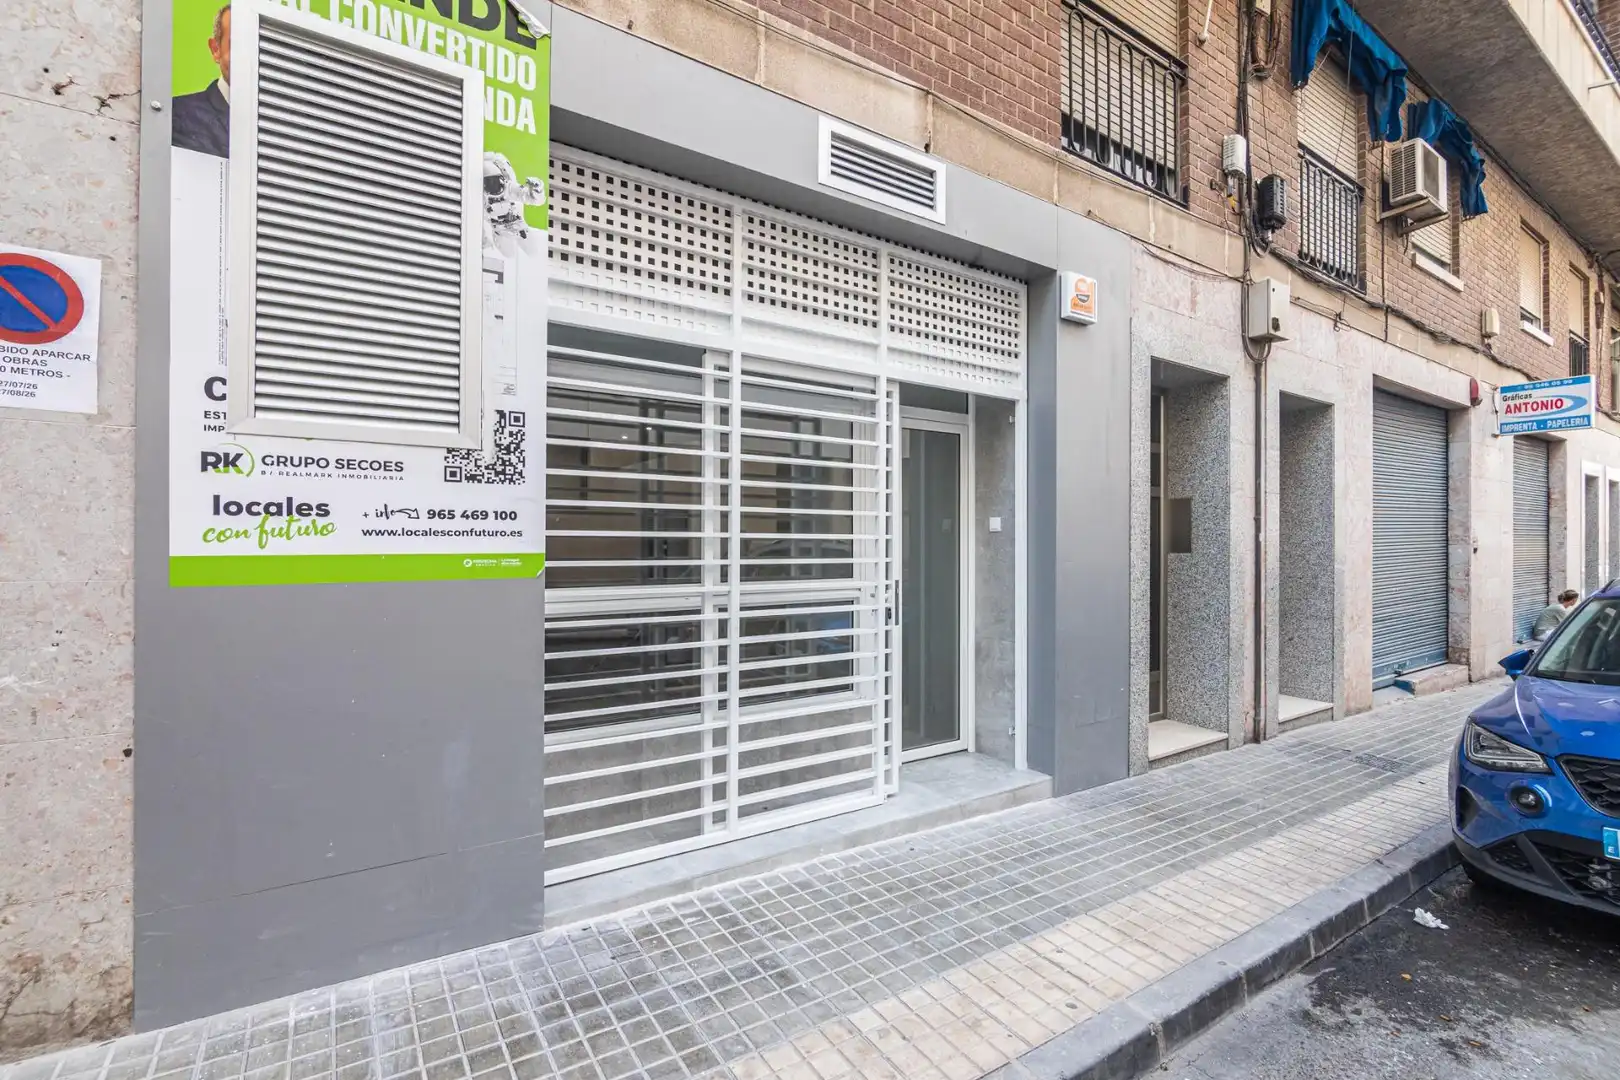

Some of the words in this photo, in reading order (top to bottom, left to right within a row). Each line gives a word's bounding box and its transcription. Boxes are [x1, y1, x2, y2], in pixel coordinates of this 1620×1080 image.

[0, 345, 28, 355] BIDO
[32, 349, 91, 361] APARCAR
[2, 356, 48, 367] OBRAS
[10, 366, 63, 378] METROS
[0, 389, 36, 397] 7/08/26
[204, 376, 227, 401] C
[1502, 393, 1533, 402] Gráficas
[1505, 398, 1564, 415] ANTONIO
[204, 410, 227, 420] EST
[204, 424, 226, 432] IMP
[1501, 422, 1538, 432] IMPRENTA
[1546, 417, 1589, 428] PAPELERIA
[201, 451, 244, 475] RK
[261, 454, 330, 469] GRUPO
[335, 457, 404, 472] SECOES
[278, 470, 333, 478] REALMARK
[337, 473, 404, 481] INMOBILIARIA
[212, 494, 331, 517] locales
[427, 509, 456, 520] 965
[460, 509, 489, 521] 469
[493, 510, 518, 521] 100
[361, 527, 523, 538] www.localesconfuturo.es
